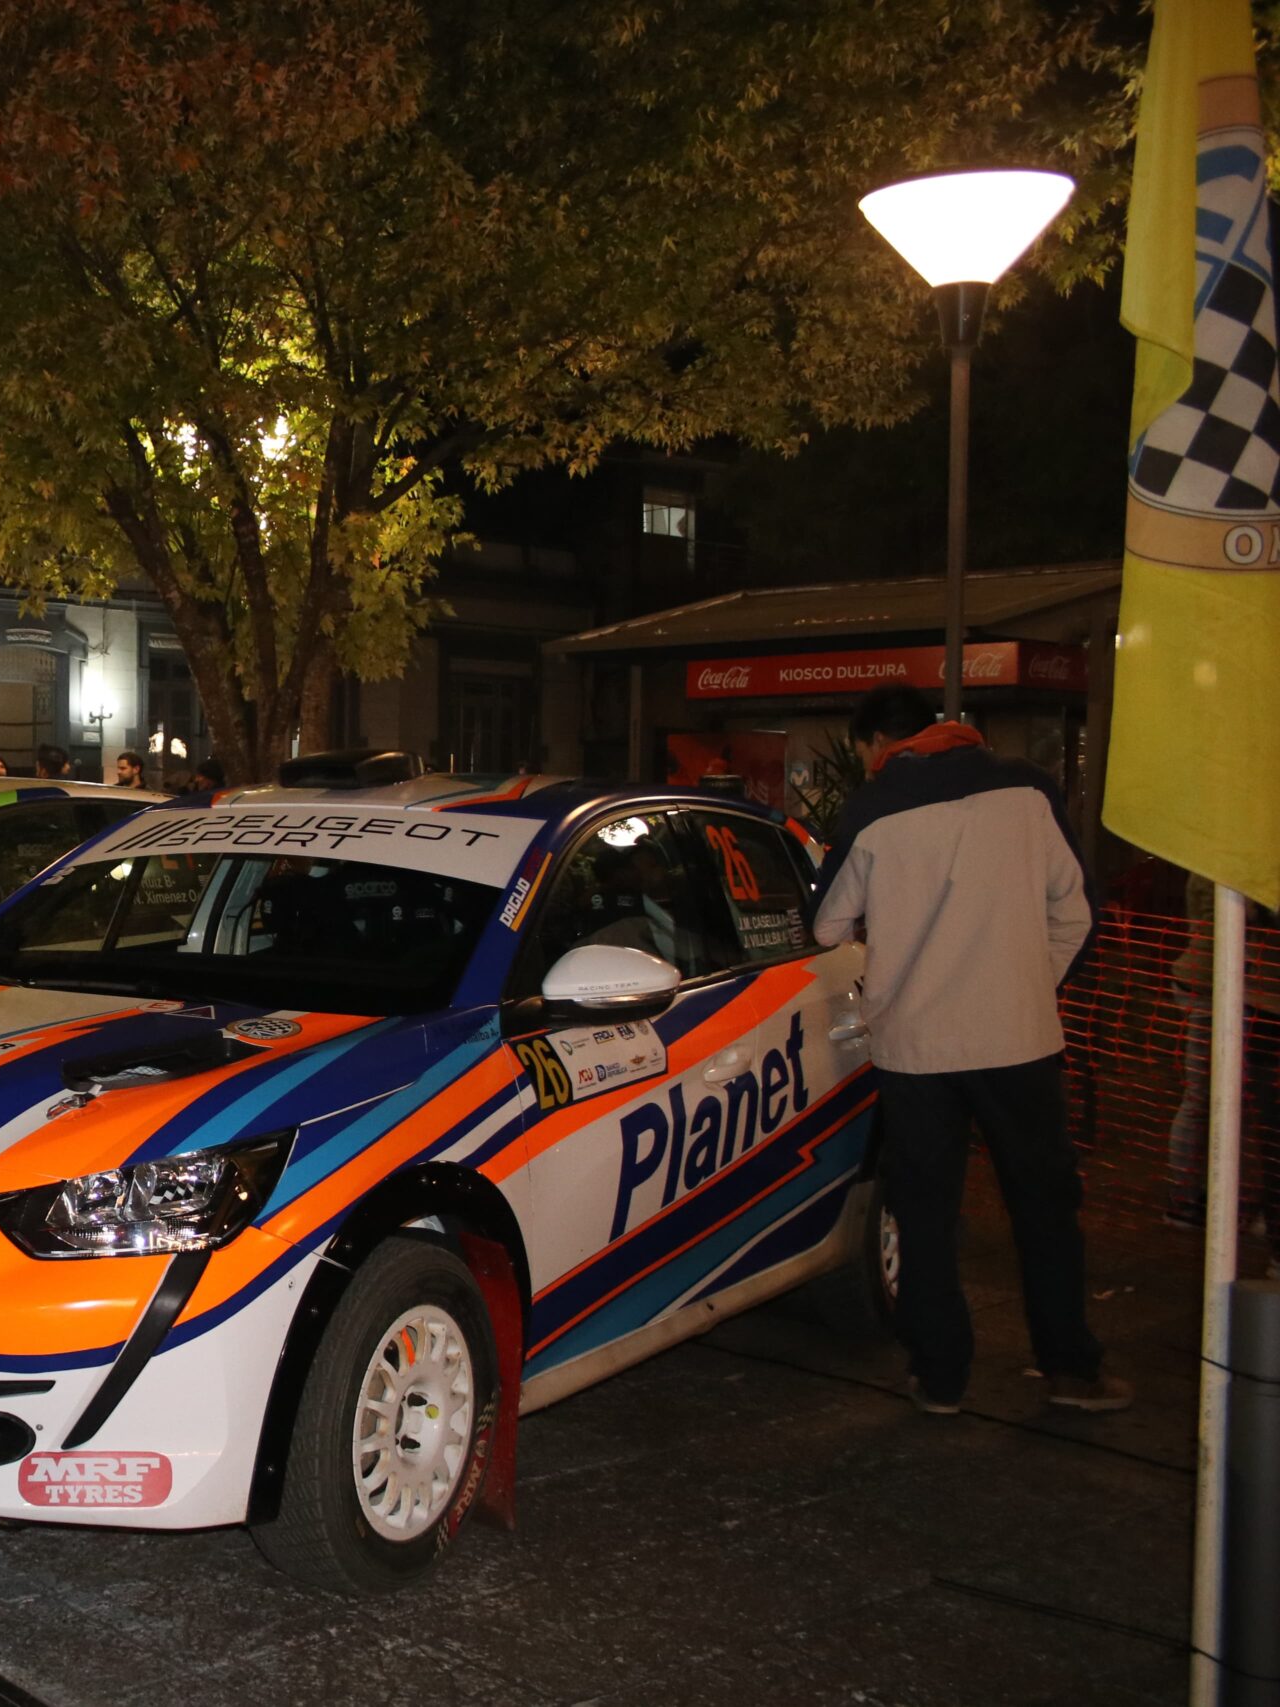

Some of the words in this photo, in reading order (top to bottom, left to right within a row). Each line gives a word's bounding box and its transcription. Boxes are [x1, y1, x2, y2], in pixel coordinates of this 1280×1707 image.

[778, 666, 834, 683] KIOSCO
[836, 662, 908, 680] DULZURA
[158, 830, 366, 850] SPORT
[188, 814, 500, 847] PEUGEOT
[705, 824, 760, 902] 26
[500, 876, 532, 928] DAGLIO
[519, 1039, 570, 1111] 26
[608, 1011, 809, 1244] Planet
[27, 1456, 161, 1483] MRF
[45, 1484, 144, 1505] TYRES
[455, 1461, 483, 1524] MRF
